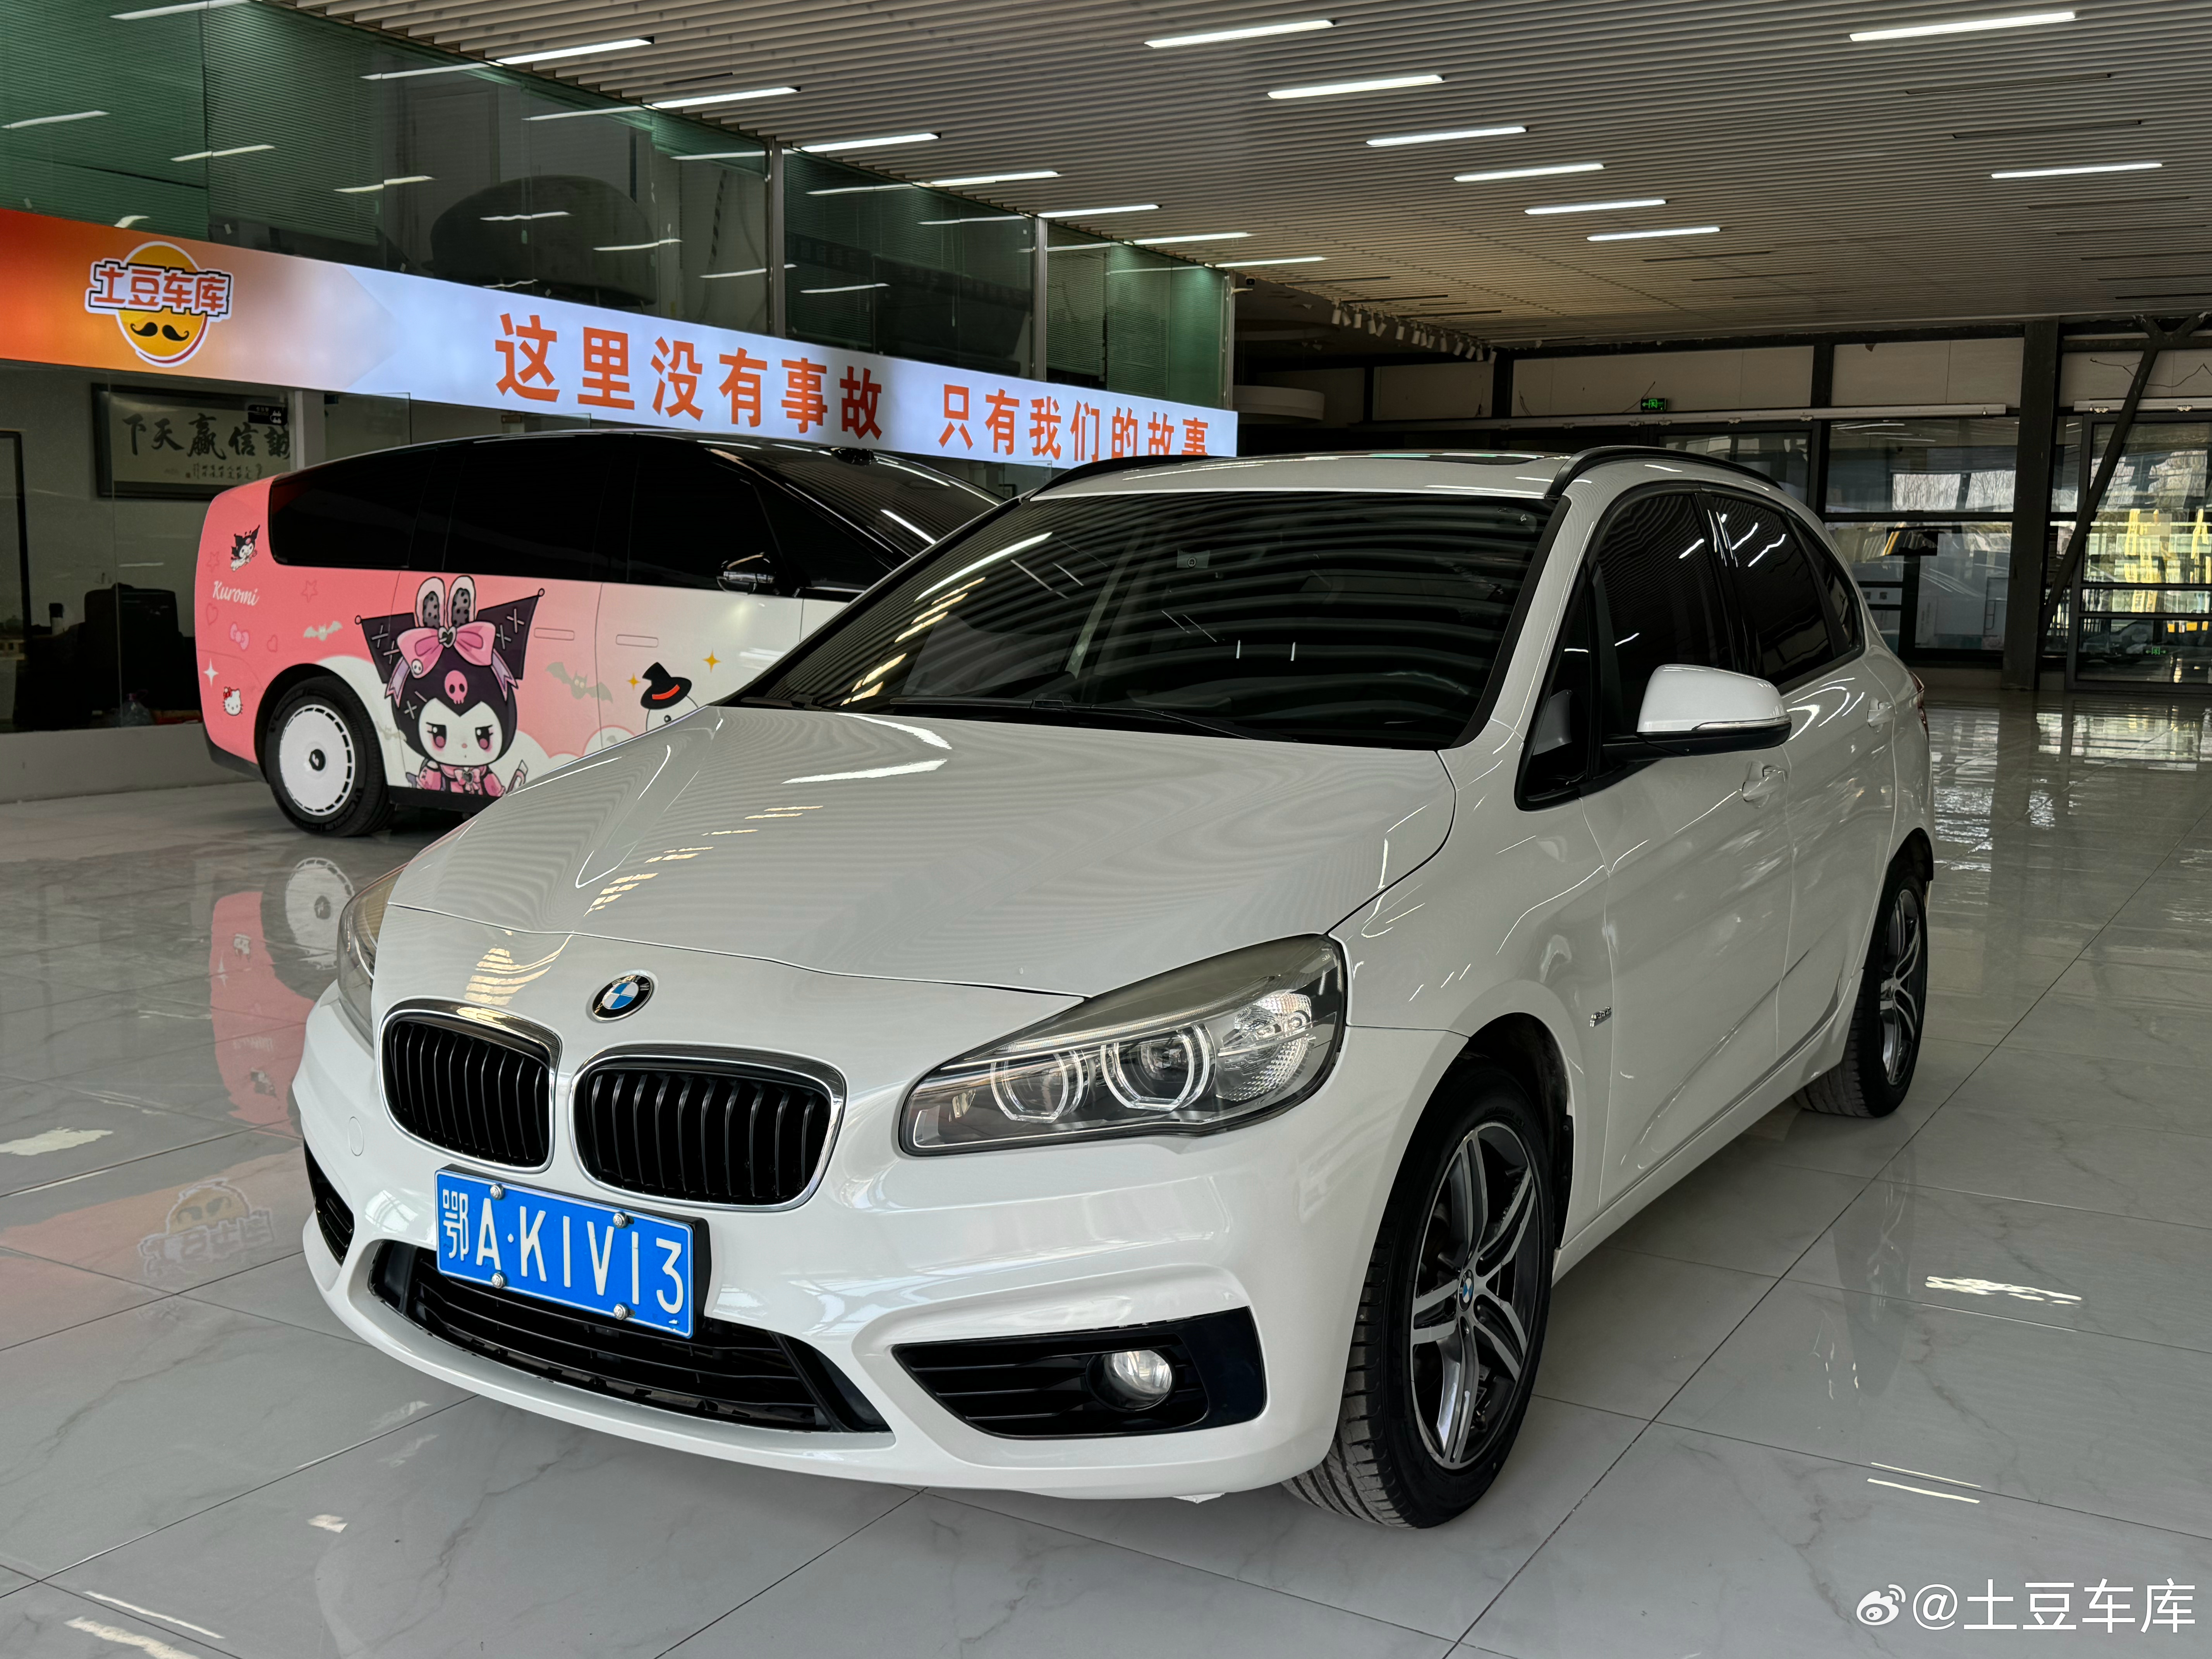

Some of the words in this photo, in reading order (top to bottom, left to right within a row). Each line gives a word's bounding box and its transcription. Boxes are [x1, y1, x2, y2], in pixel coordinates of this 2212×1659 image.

[93, 266, 225, 311] 土豆车库
[495, 313, 882, 440] 这里没有事故
[938, 383, 1209, 462] 只有我们的故事
[213, 580, 260, 606] Kuromi
